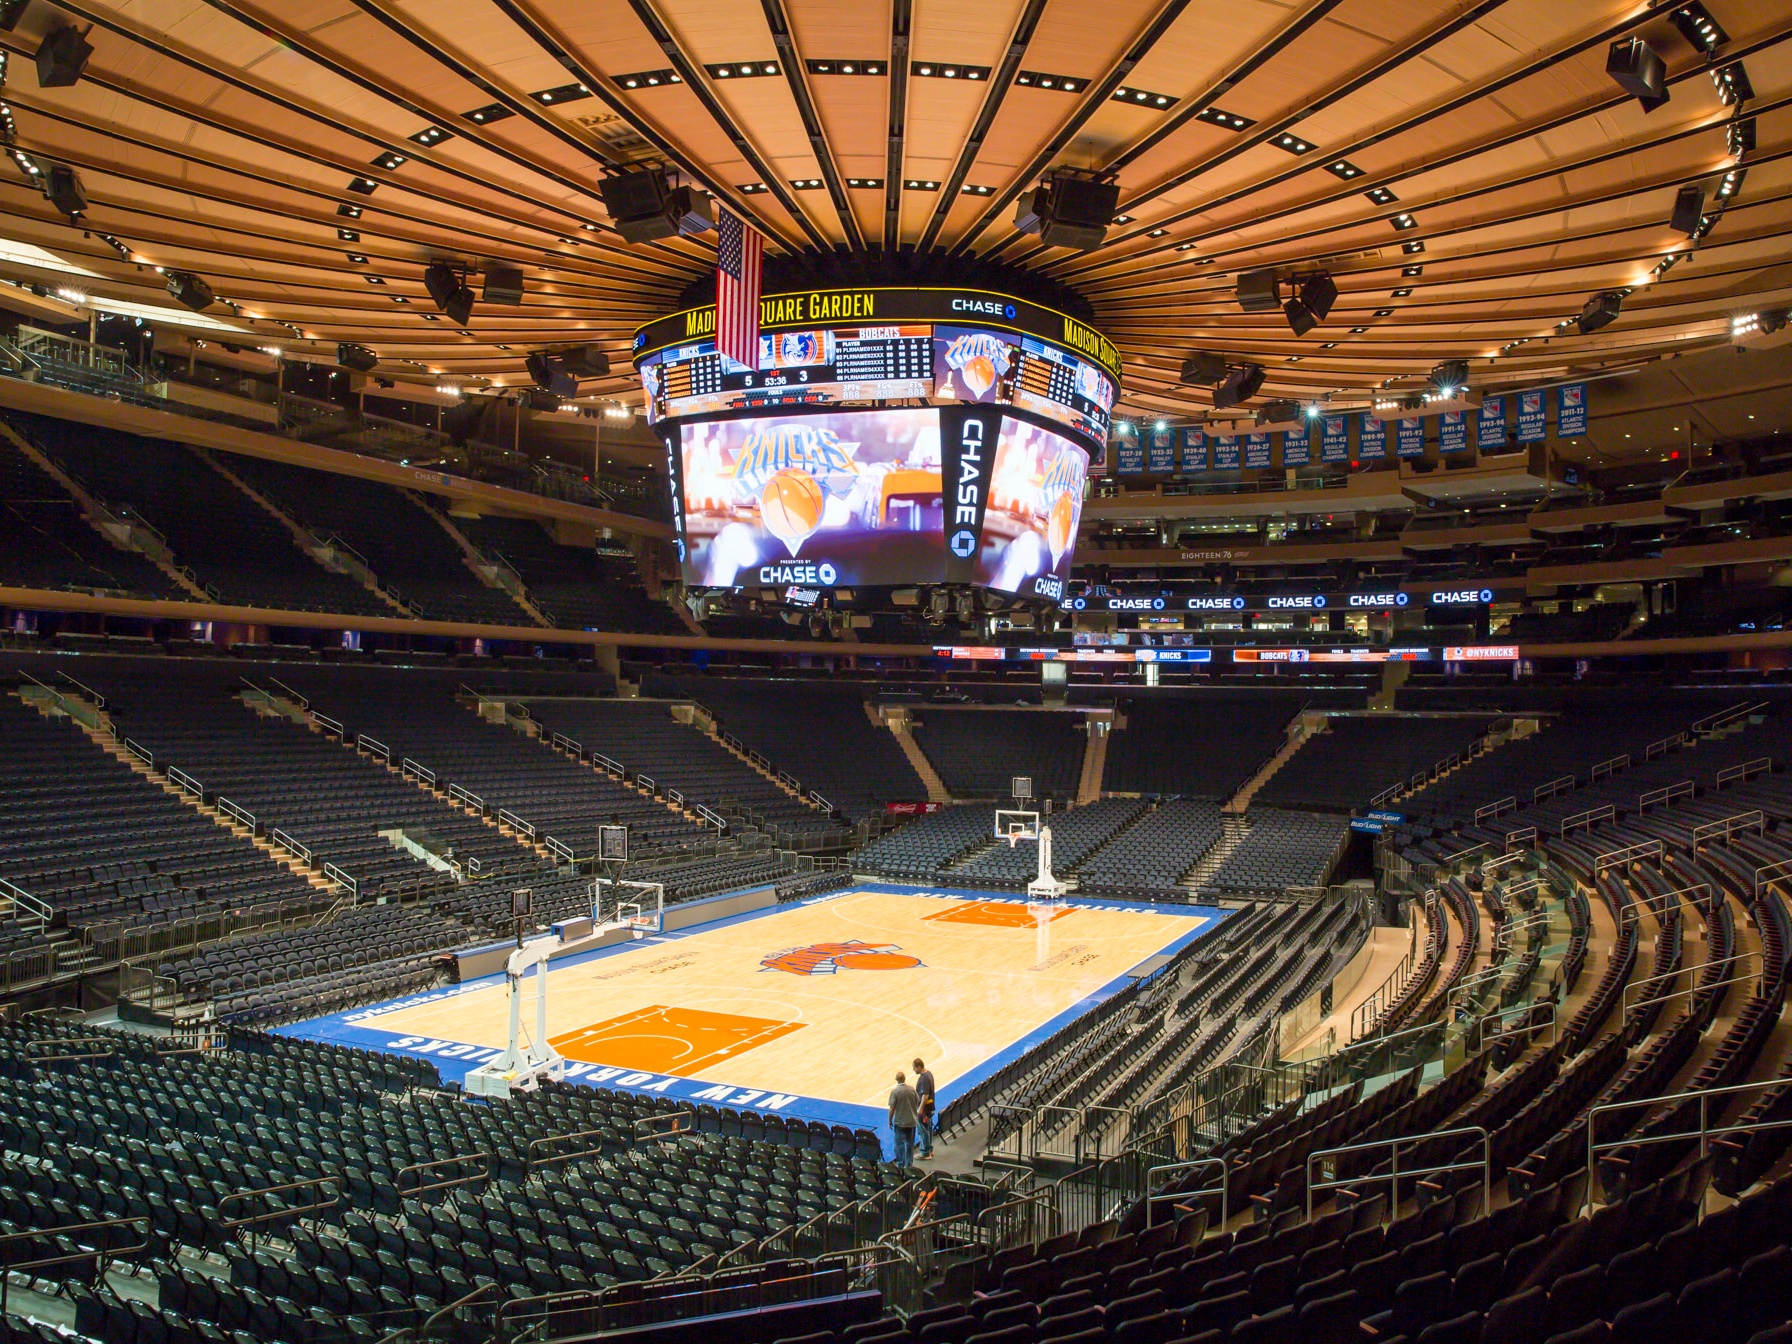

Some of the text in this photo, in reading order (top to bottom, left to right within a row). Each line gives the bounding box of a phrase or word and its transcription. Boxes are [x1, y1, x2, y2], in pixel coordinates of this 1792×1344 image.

[686, 310, 716, 336] MADI
[810, 294, 874, 319] GARDEN
[952, 299, 1003, 315] CHASE
[860, 328, 900, 338] BOBCATS
[1064, 317, 1099, 357] MADISON
[745, 370, 807, 386] 5 53:36 3
[1519, 413, 1545, 422] 1993-94
[1561, 408, 1584, 416] 2011-12
[1480, 419, 1504, 428] 1993-94
[1559, 427, 1586, 435] CHAMPIONS
[732, 427, 860, 480] KNICKS
[956, 418, 984, 526] CHASE
[760, 566, 817, 583] CHASE
[1036, 578, 1058, 598] CHASE
[1109, 600, 1152, 608] CHASE
[1188, 599, 1231, 608] CHASE
[1268, 597, 1312, 608] CHASE
[1350, 595, 1394, 606] CHASE
[1433, 591, 1478, 603] CHASE
[1466, 648, 1513, 657] @NYKNICKS
[978, 896, 1044, 906] YORK
[1060, 903, 1158, 914] KNICKS
[342, 982, 494, 1022] nyknicks.com
[565, 1062, 680, 1092] YORK
[690, 1085, 799, 1110] NEW
